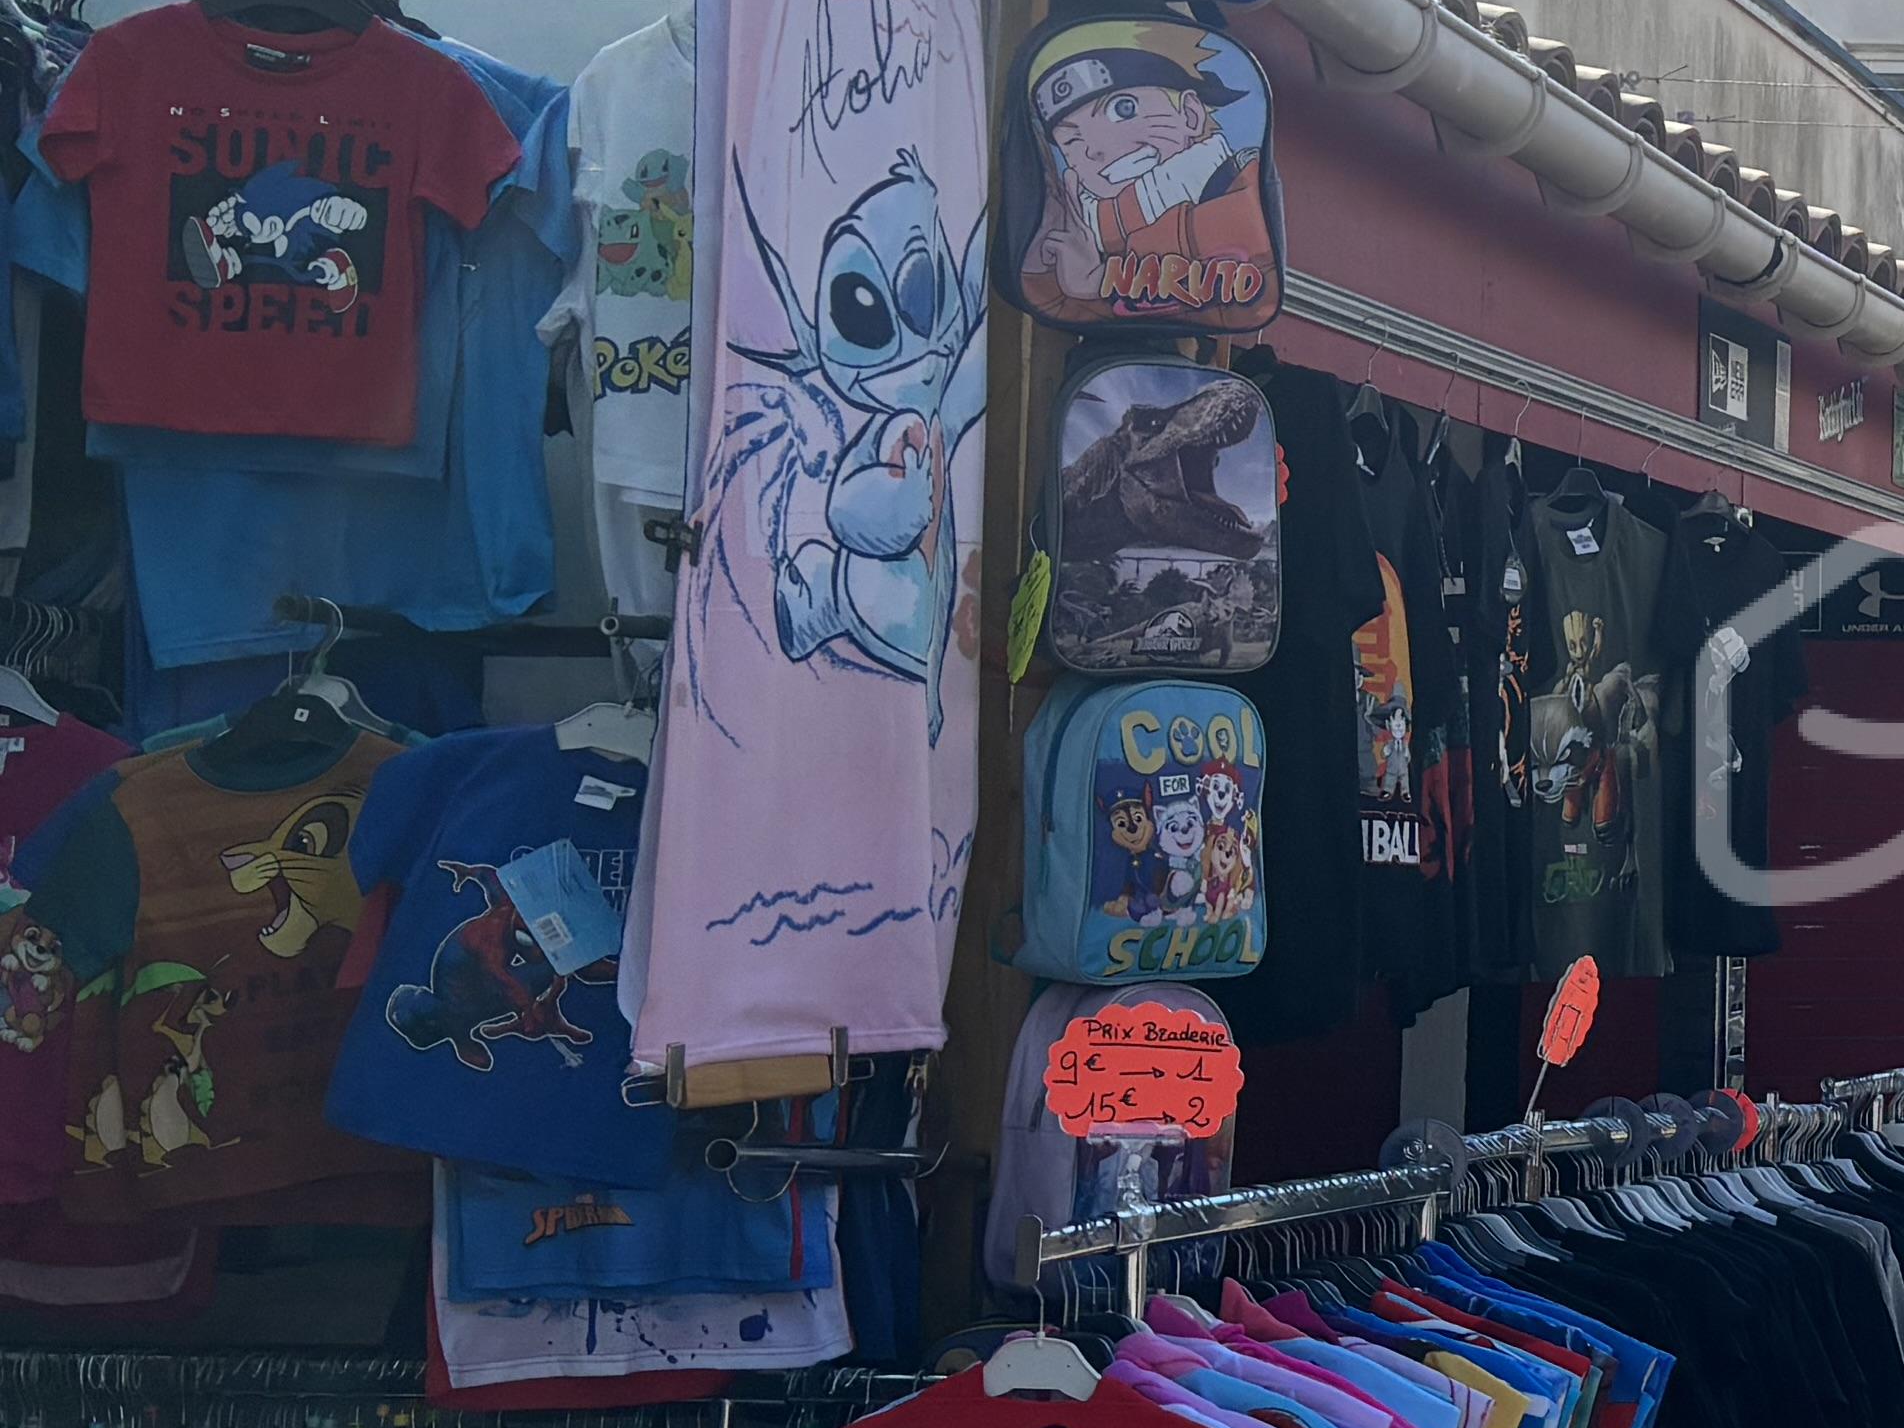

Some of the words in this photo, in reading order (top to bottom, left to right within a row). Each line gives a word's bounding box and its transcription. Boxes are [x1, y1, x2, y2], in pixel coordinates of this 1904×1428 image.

[169, 124, 394, 187] SONIC
[1101, 251, 1264, 309] NARUTO
[1841, 623, 1887, 633] UNDER
[1121, 706, 1260, 775] COOL
[1162, 775, 1190, 795] FOR
[1106, 922, 1260, 976] SCHOOL
[1184, 1097, 1211, 1127] 2
